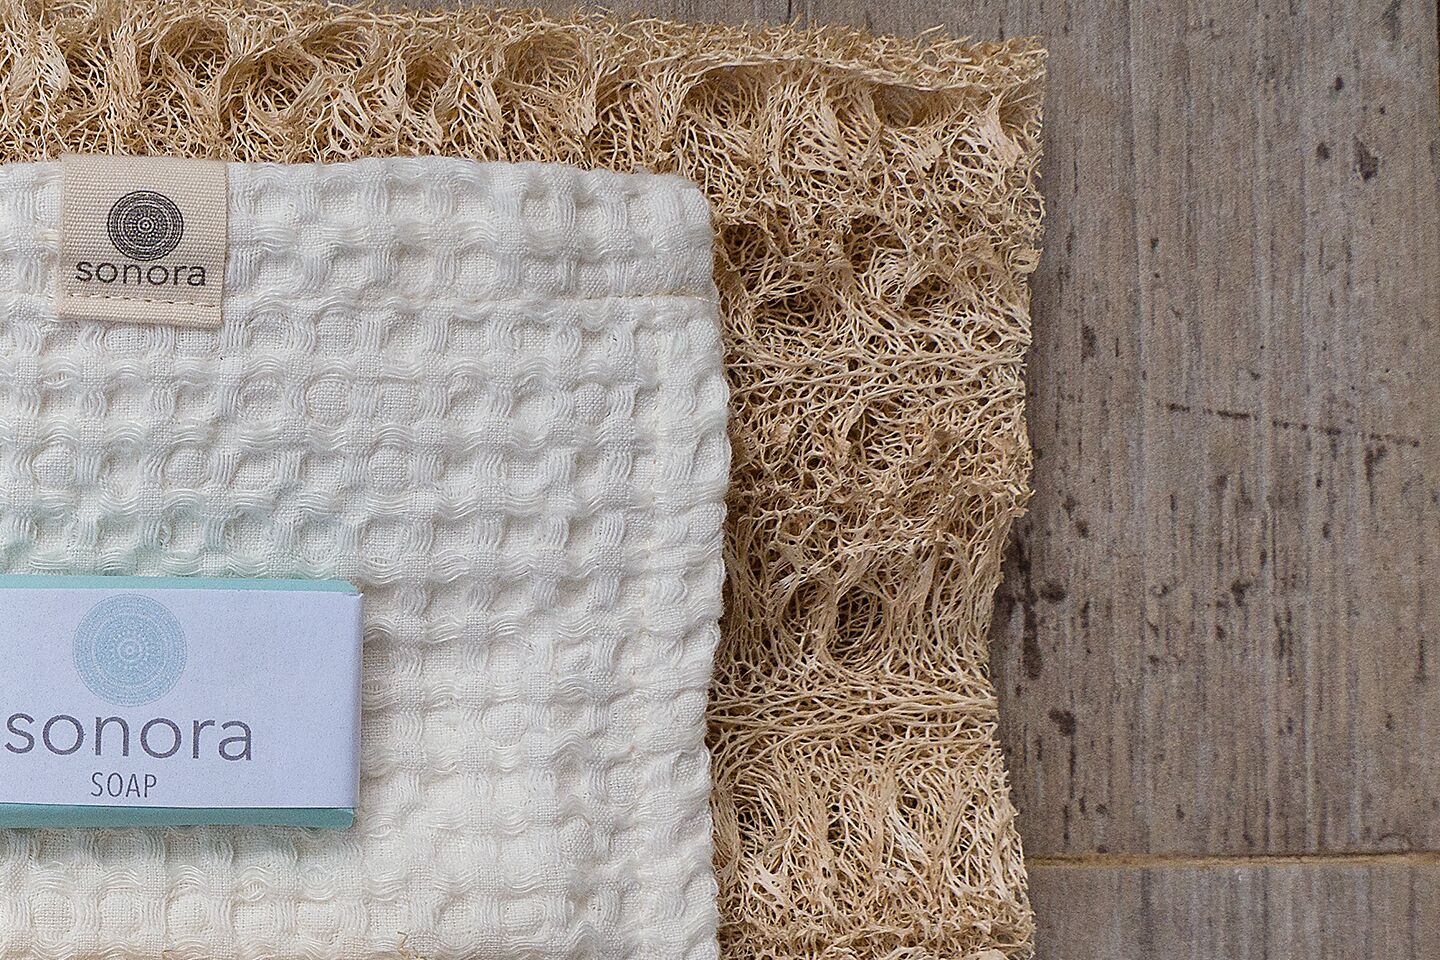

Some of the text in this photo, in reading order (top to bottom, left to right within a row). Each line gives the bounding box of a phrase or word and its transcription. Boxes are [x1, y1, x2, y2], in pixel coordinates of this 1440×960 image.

[75, 261, 206, 286] sonora
[4, 713, 252, 761] sonora
[90, 771, 158, 798] SOAP
